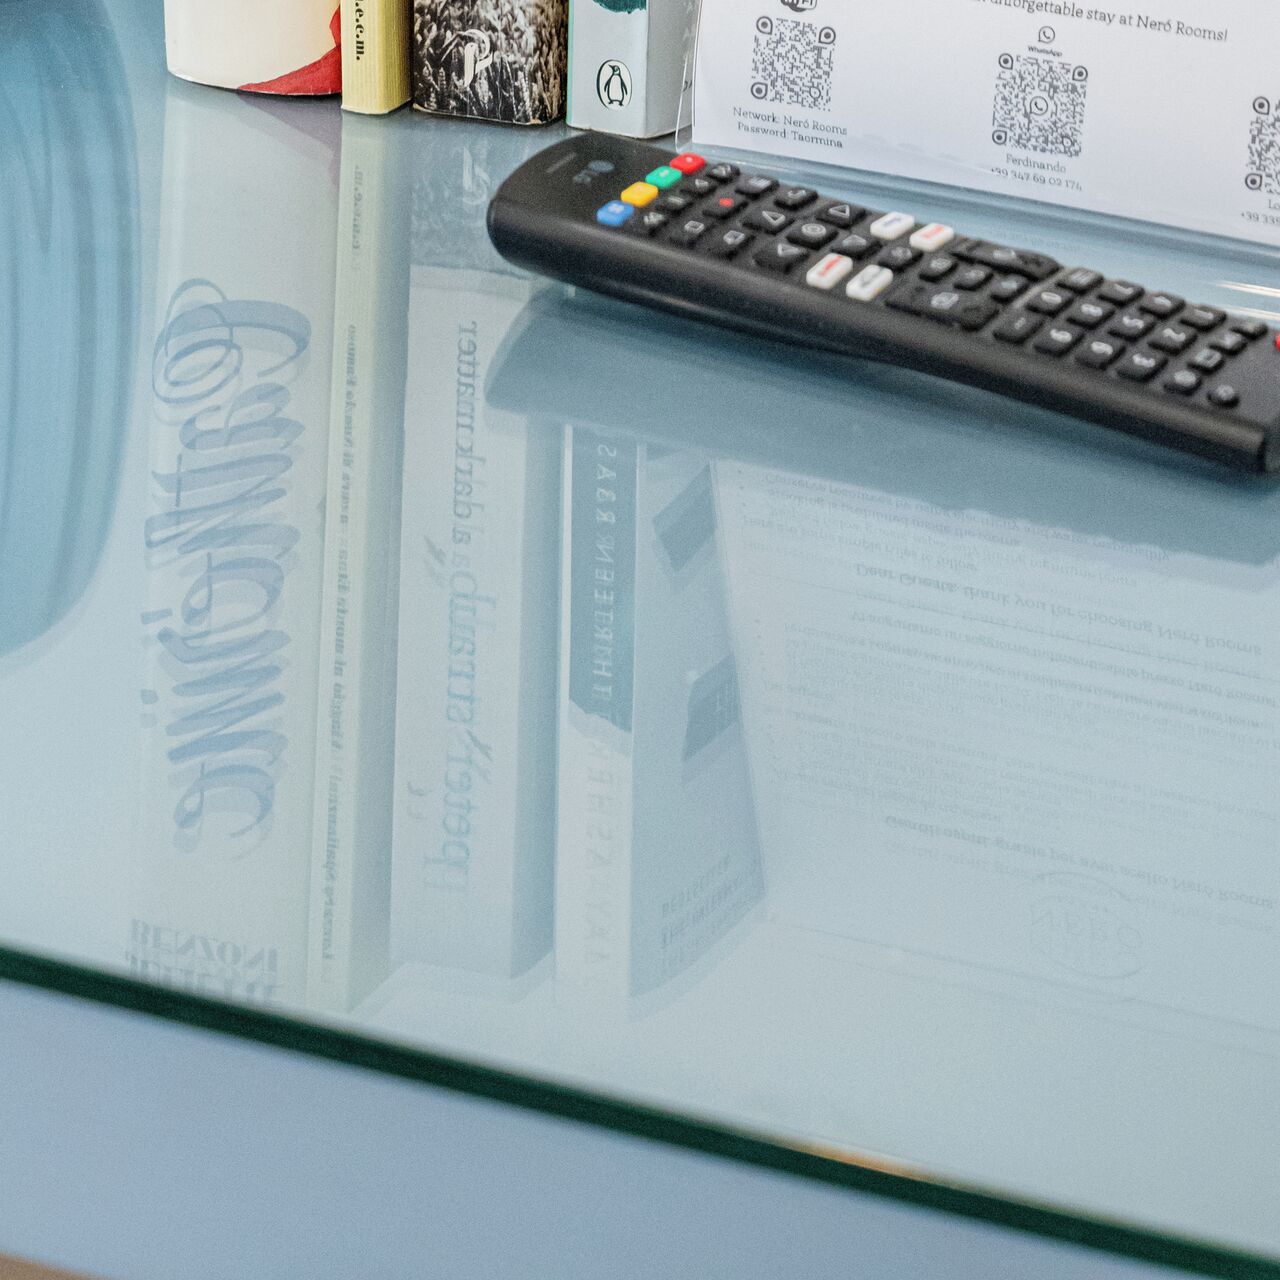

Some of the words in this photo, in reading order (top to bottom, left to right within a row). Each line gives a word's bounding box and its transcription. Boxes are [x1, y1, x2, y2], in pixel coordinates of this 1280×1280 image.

[1085, 8, 1116, 26] stay
[1118, 14, 1134, 26] at
[1135, 13, 1172, 33] Neró
